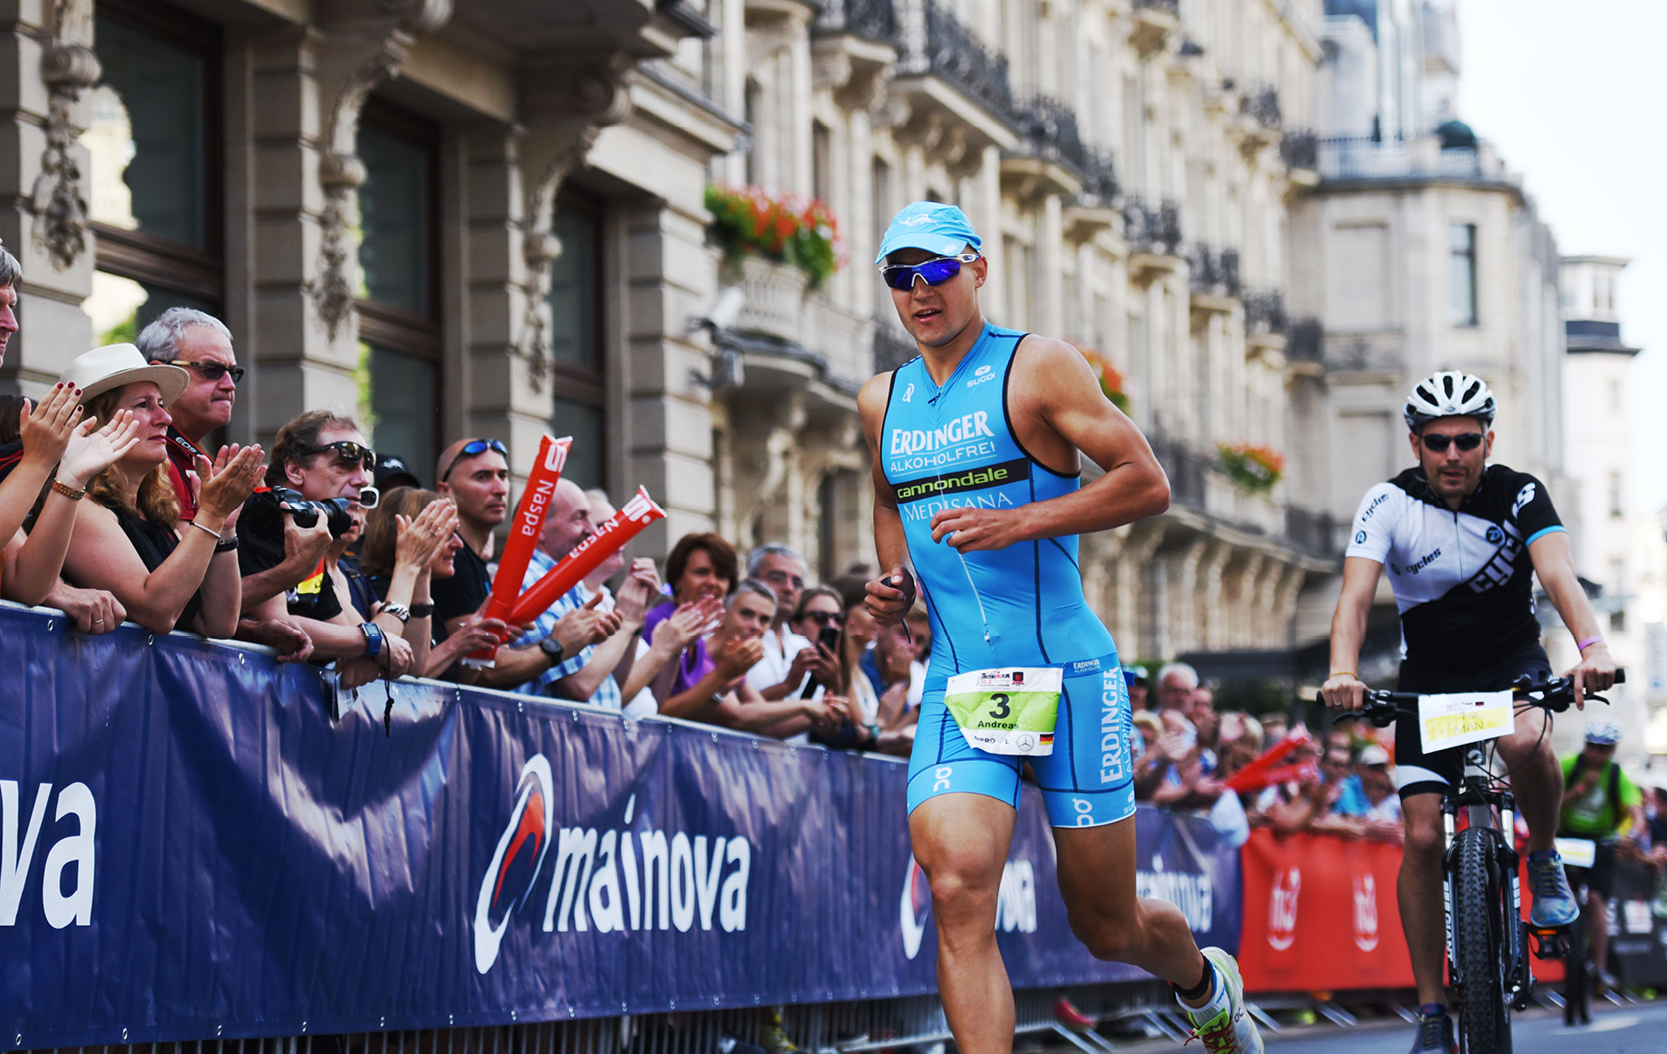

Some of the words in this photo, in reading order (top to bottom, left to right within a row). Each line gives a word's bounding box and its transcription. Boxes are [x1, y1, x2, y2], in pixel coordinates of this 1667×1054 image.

[966, 372, 996, 388] SUGOI
[175, 436, 198, 454] EOS
[890, 410, 995, 456] ERDINGER
[890, 441, 996, 473] ALKOHOLFREI
[897, 467, 1009, 499] cannondale
[521, 479, 554, 537] Naspa
[903, 491, 1014, 523] MEDISANA
[1405, 547, 1442, 575] cycles
[989, 693, 1011, 719] 3
[977, 720, 1019, 730] Andreas
[1100, 666, 1123, 784] ERDINGER
[542, 793, 751, 934] mainova
